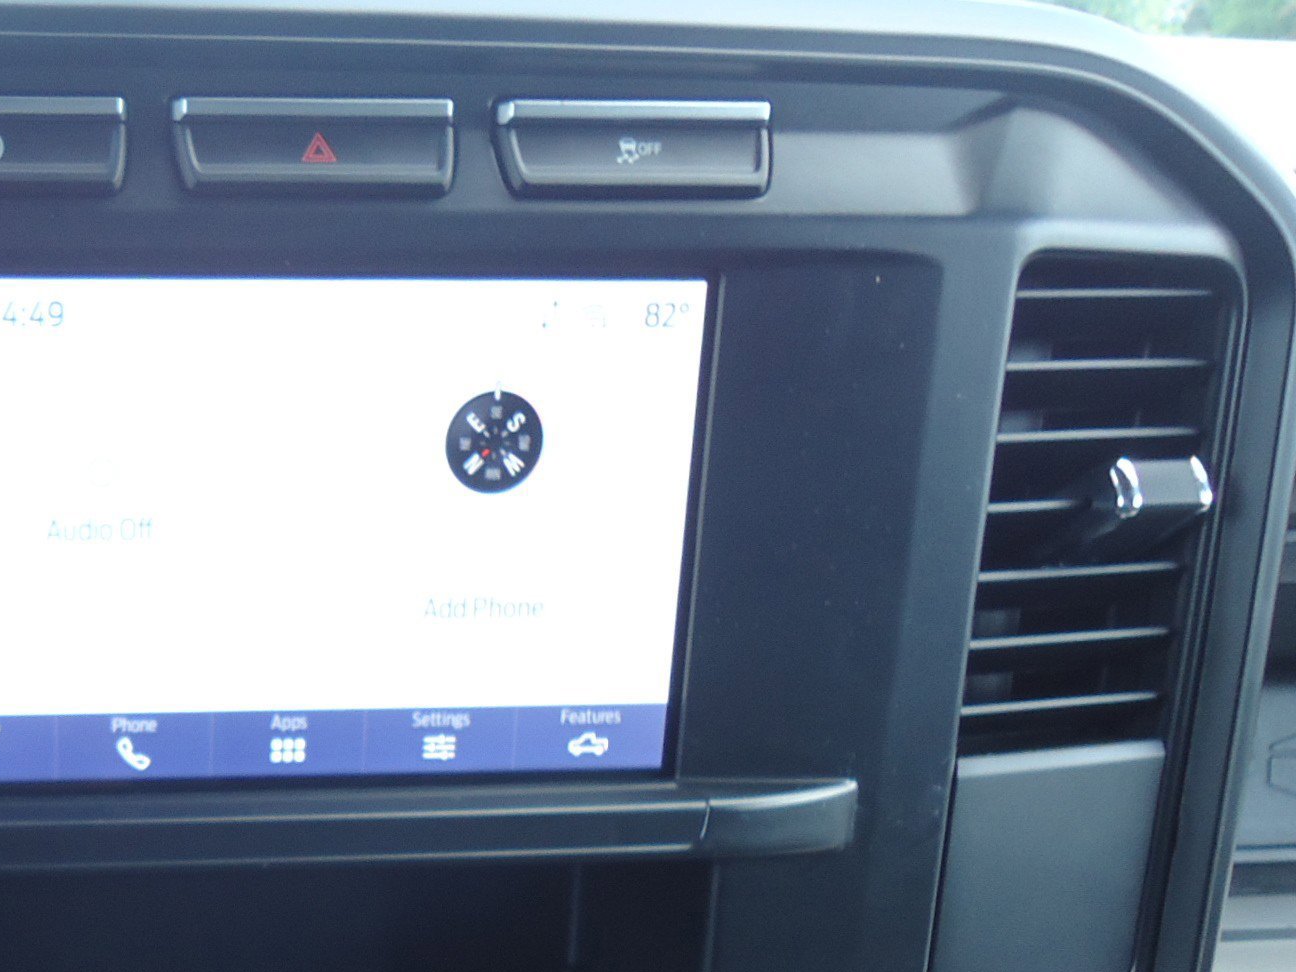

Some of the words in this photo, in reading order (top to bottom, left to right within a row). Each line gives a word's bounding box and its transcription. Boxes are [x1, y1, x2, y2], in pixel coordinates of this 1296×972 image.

[638, 141, 662, 156] OFF
[1, 300, 65, 329] 4:49
[466, 411, 486, 433] E
[507, 411, 525, 433] S
[463, 451, 484, 475] N
[46, 517, 113, 542] Audio
[118, 517, 155, 542] Off
[423, 595, 468, 619] Add
[473, 595, 545, 619] Phone
[111, 716, 158, 734] Phone
[270, 713, 308, 732] Apps
[412, 710, 472, 730] Settings
[560, 708, 622, 726] Features
